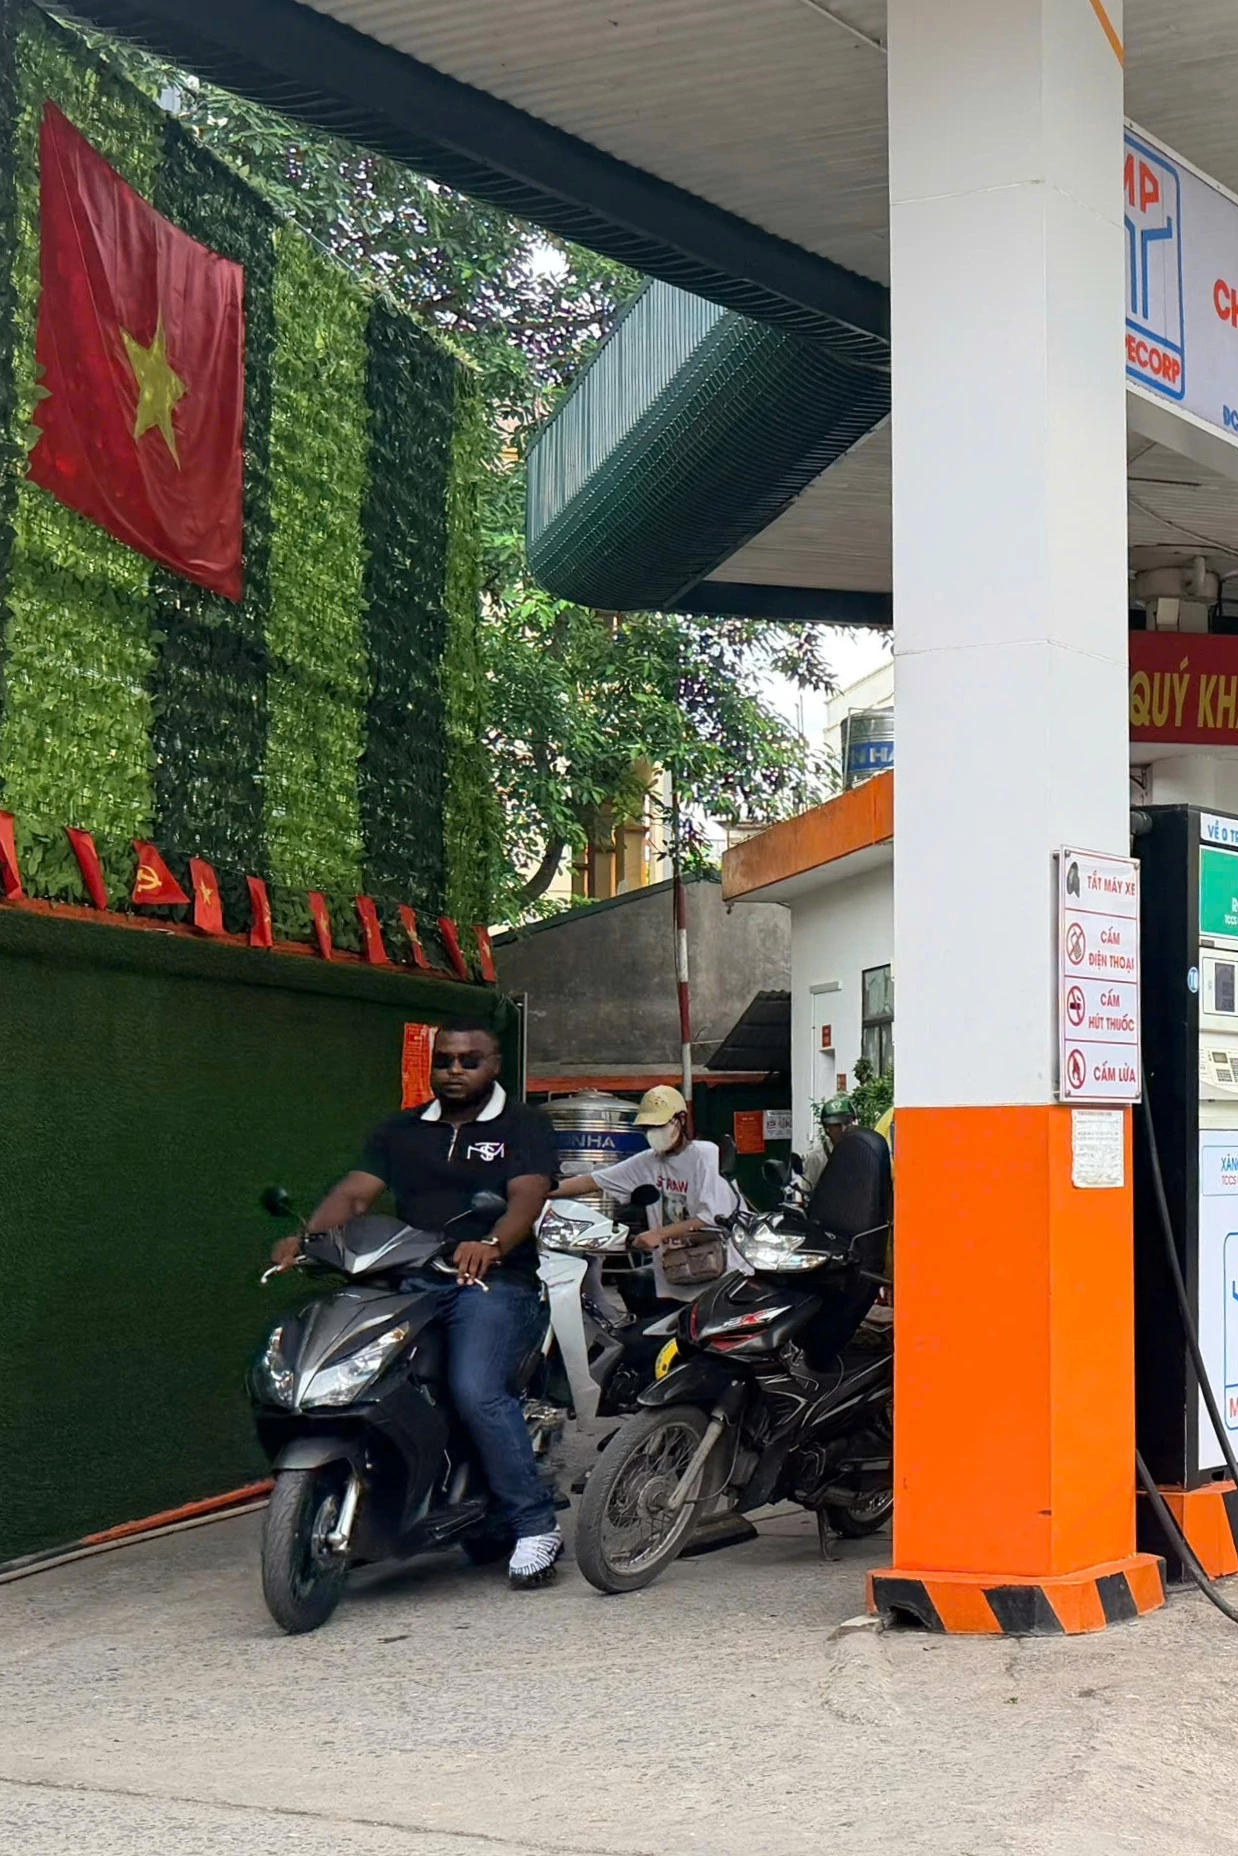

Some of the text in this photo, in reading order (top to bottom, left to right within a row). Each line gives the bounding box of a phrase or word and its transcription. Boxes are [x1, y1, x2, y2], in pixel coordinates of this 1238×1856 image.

[1126, 335, 1181, 383] ECORP
[1130, 656, 1190, 728] QUÝ
[1221, 828, 1228, 841] 0
[1087, 870, 1136, 896] TẮT MÁY XE
[1100, 926, 1120, 945] CẤM
[1088, 950, 1135, 974] ĐIỆN THOẠI
[1100, 988, 1120, 1007] CẤM
[1088, 1013, 1135, 1032] HÚT THUỐC
[1093, 1060, 1136, 1083] CẤM LỬA
[656, 1175, 688, 1193] SRAW
